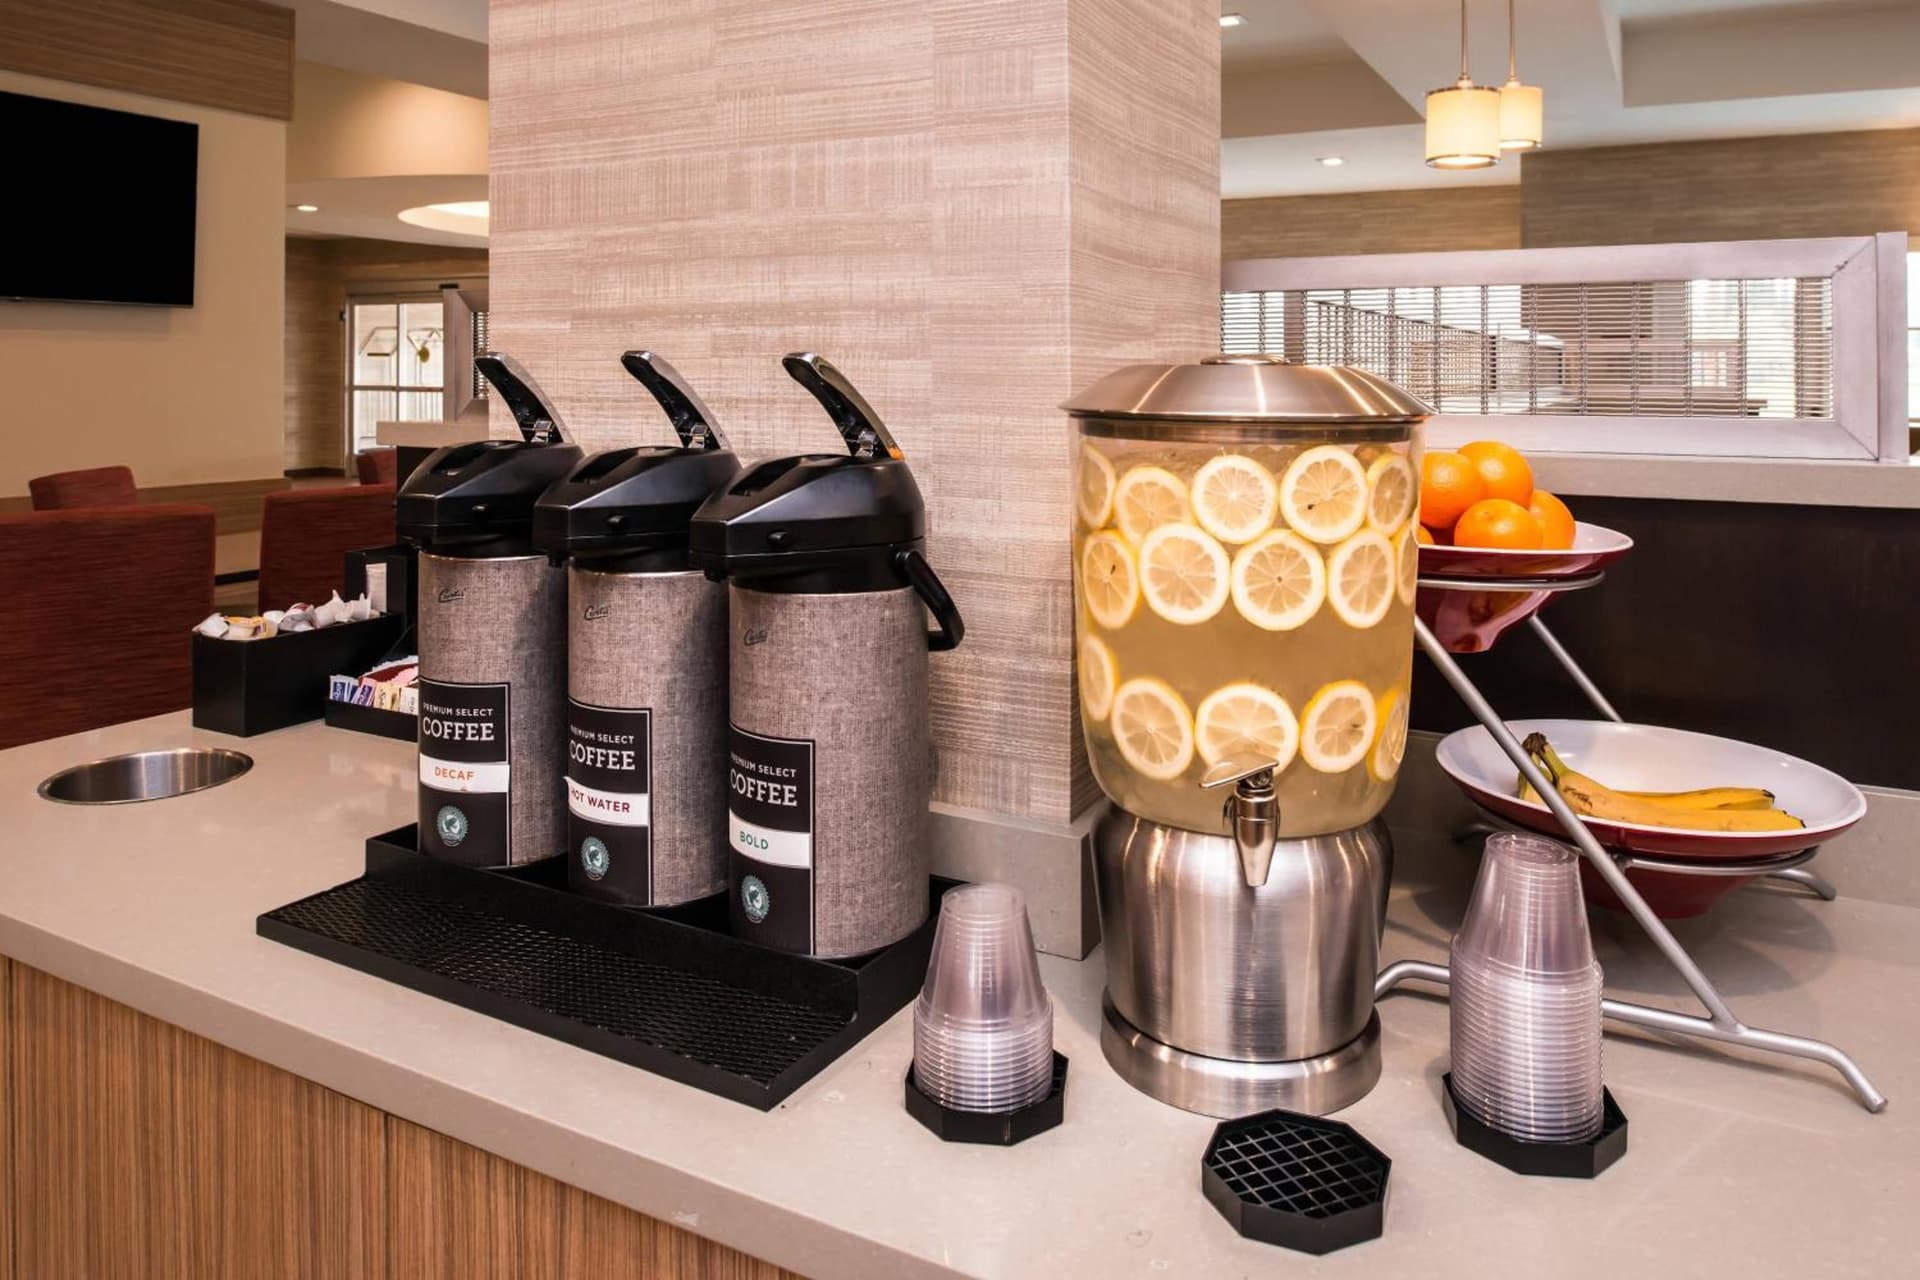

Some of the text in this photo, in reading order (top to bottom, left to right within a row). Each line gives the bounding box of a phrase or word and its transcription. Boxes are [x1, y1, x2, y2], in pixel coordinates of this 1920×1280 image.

[423, 702, 453, 715] PREMIUM
[455, 708, 494, 717] SELECT
[423, 716, 495, 741] COFFEE
[597, 733, 635, 745] SELECT
[569, 739, 636, 770] COFFEE
[434, 766, 475, 781] DECAF
[758, 764, 798, 778] SELECT
[730, 768, 798, 807] COFFEE
[587, 796, 631, 813] WATER
[740, 831, 769, 850] BOLD
